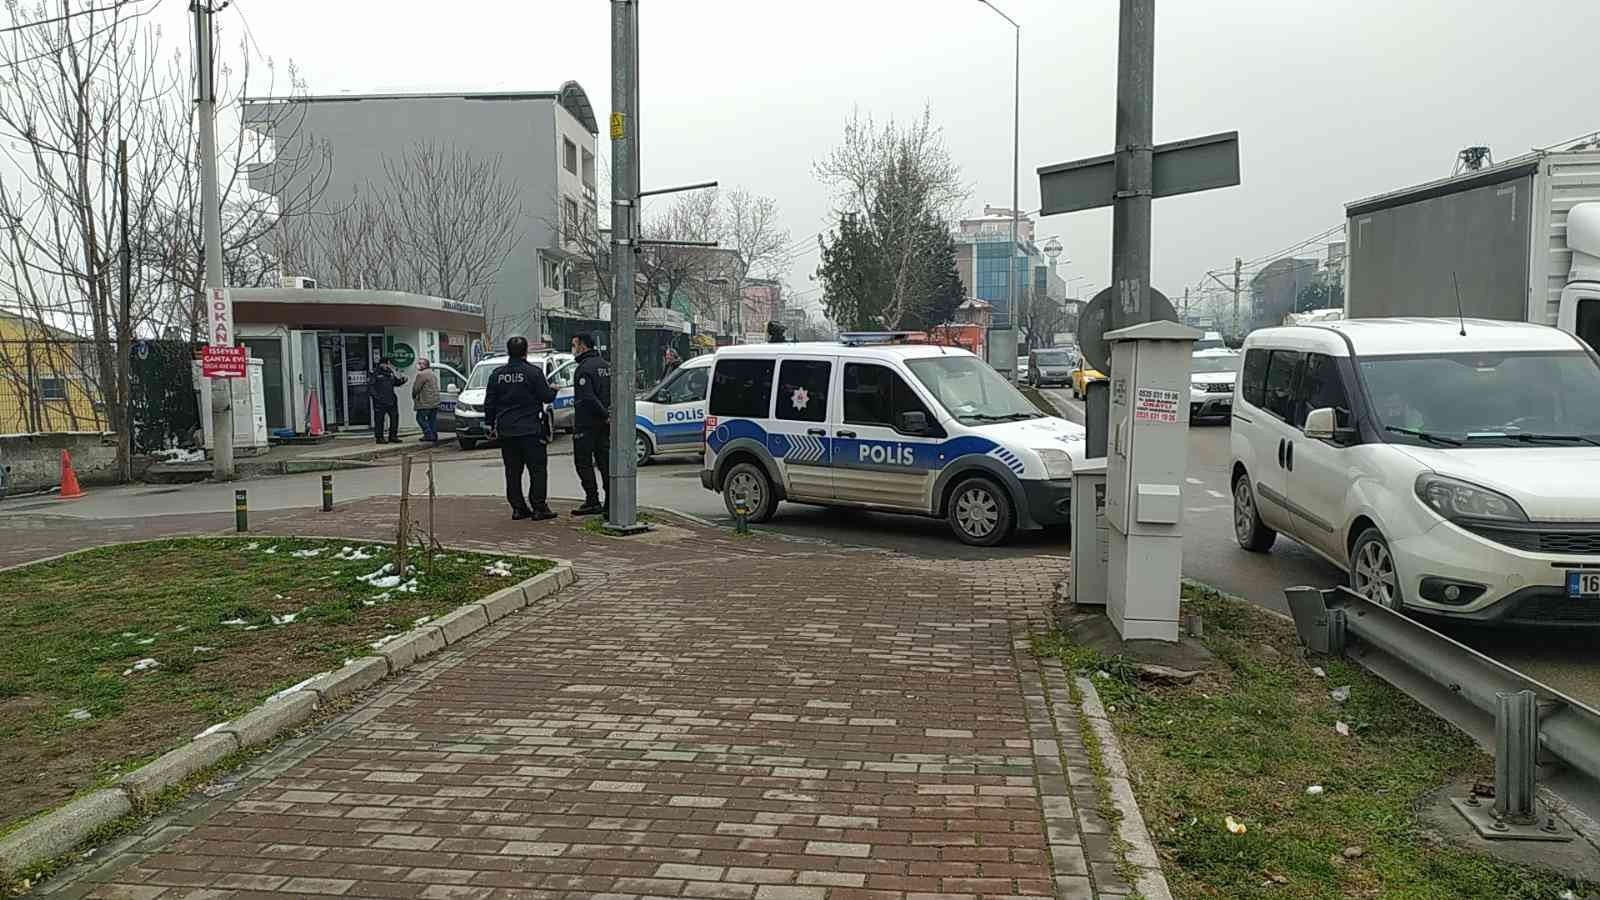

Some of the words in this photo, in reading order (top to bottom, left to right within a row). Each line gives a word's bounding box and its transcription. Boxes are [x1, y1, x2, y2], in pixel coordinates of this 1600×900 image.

[666, 408, 705, 422] POLİS
[859, 443, 914, 465] POLİS
[1582, 575, 1599, 592] 16
